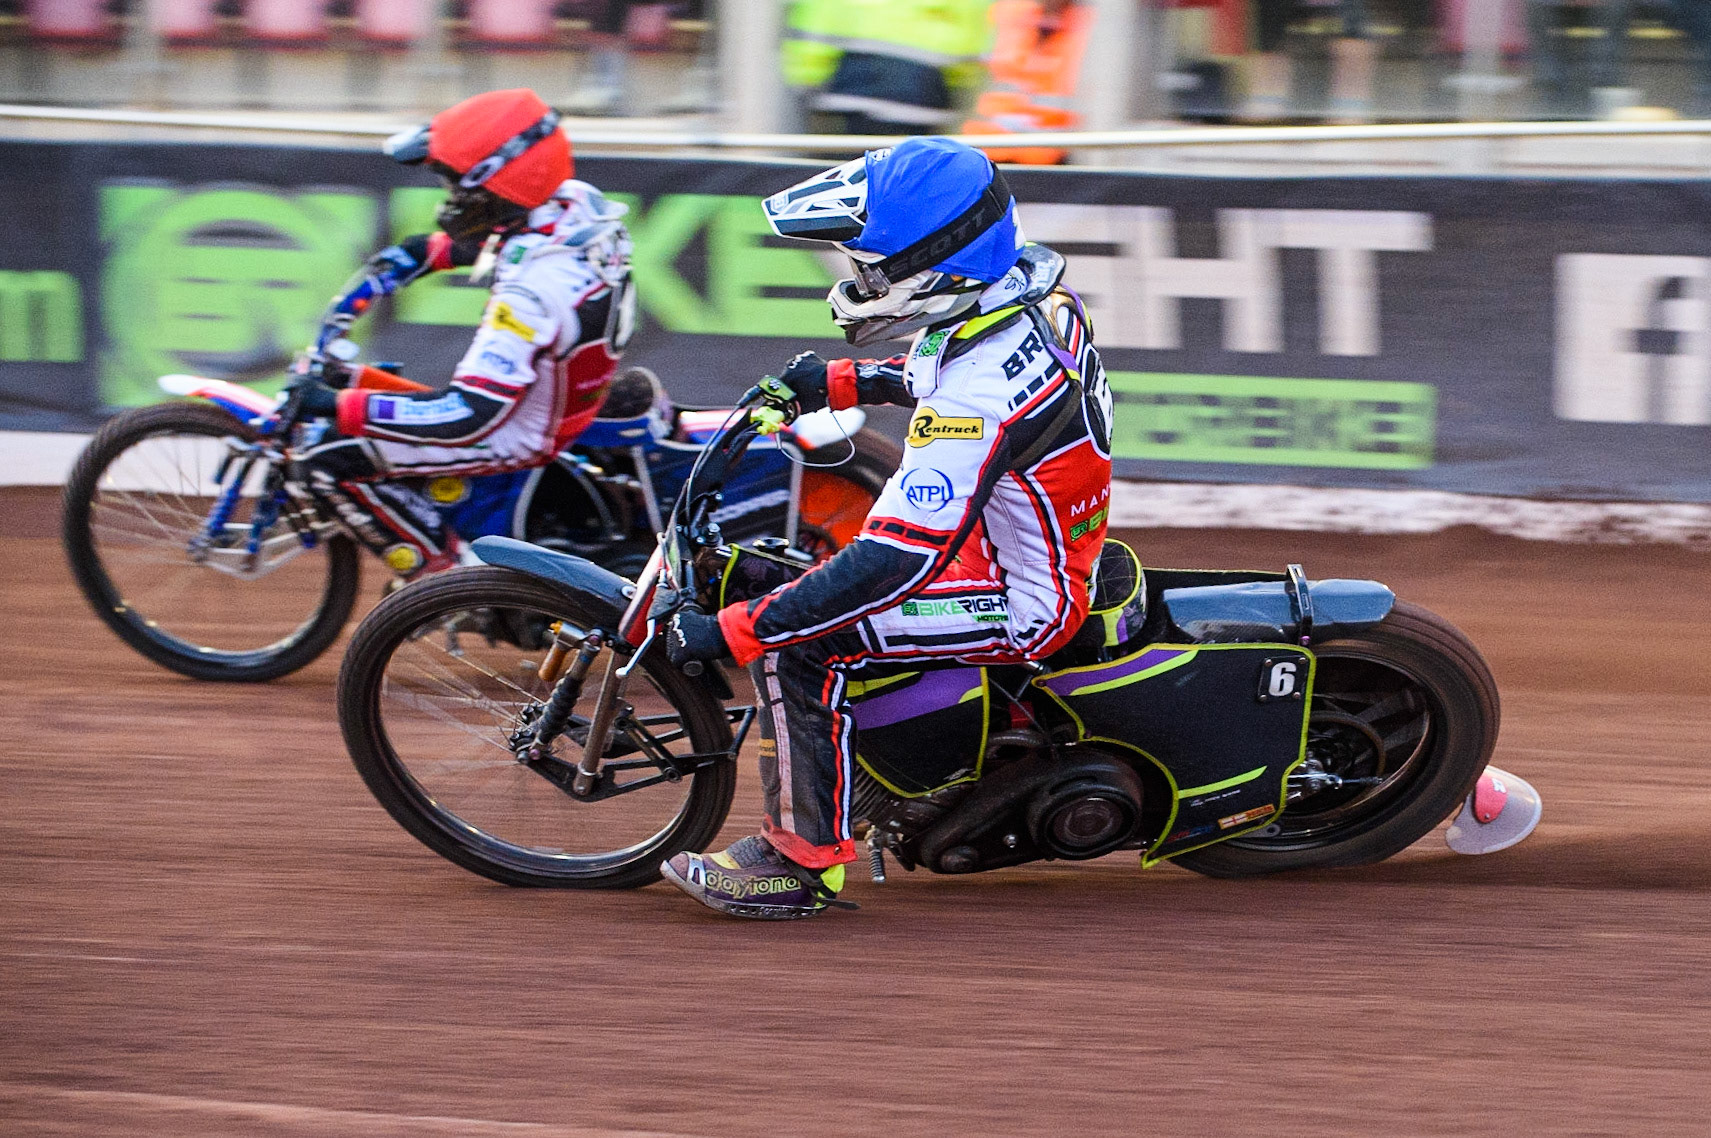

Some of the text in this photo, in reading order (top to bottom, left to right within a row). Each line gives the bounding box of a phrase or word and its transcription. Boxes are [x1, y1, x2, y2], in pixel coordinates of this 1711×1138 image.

[889, 207, 986, 277] SCOTT
[1001, 331, 1044, 381] BR
[912, 415, 980, 439] Rentruck
[906, 485, 945, 502] ATPI
[1071, 484, 1110, 517] MAN
[1269, 662, 1297, 697] 6
[705, 869, 802, 899] daytona
